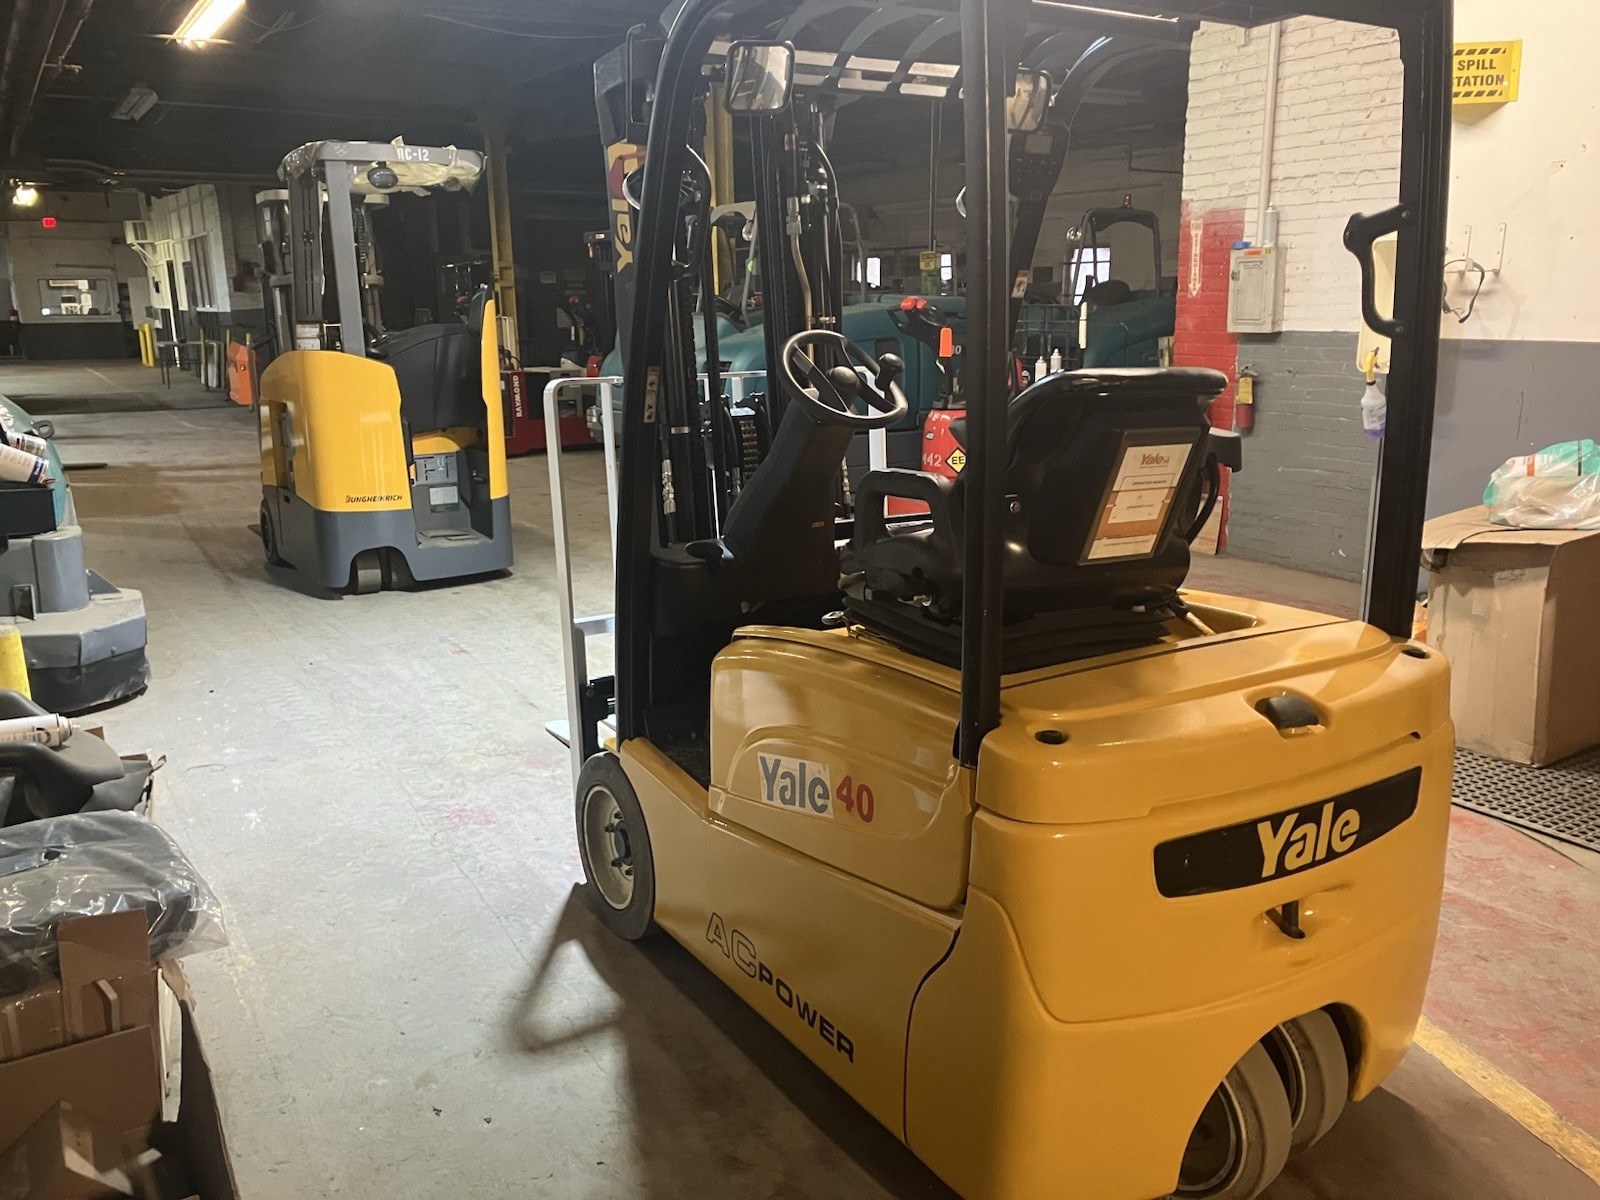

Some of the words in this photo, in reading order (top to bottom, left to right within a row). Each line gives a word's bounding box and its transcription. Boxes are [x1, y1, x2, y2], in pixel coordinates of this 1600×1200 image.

[1457, 59, 1497, 71] SPILL
[1454, 74, 1505, 87] TATION
[512, 374, 523, 418] RAYMOND
[951, 455, 966, 465] EE
[1141, 454, 1164, 465] Yale
[345, 494, 403, 504] JUNGHEINRICH
[759, 756, 831, 814] Yale
[835, 775, 875, 823] 40
[1257, 801, 1360, 878] Yale
[706, 912, 757, 979] AC
[758, 961, 855, 1064] POWER
